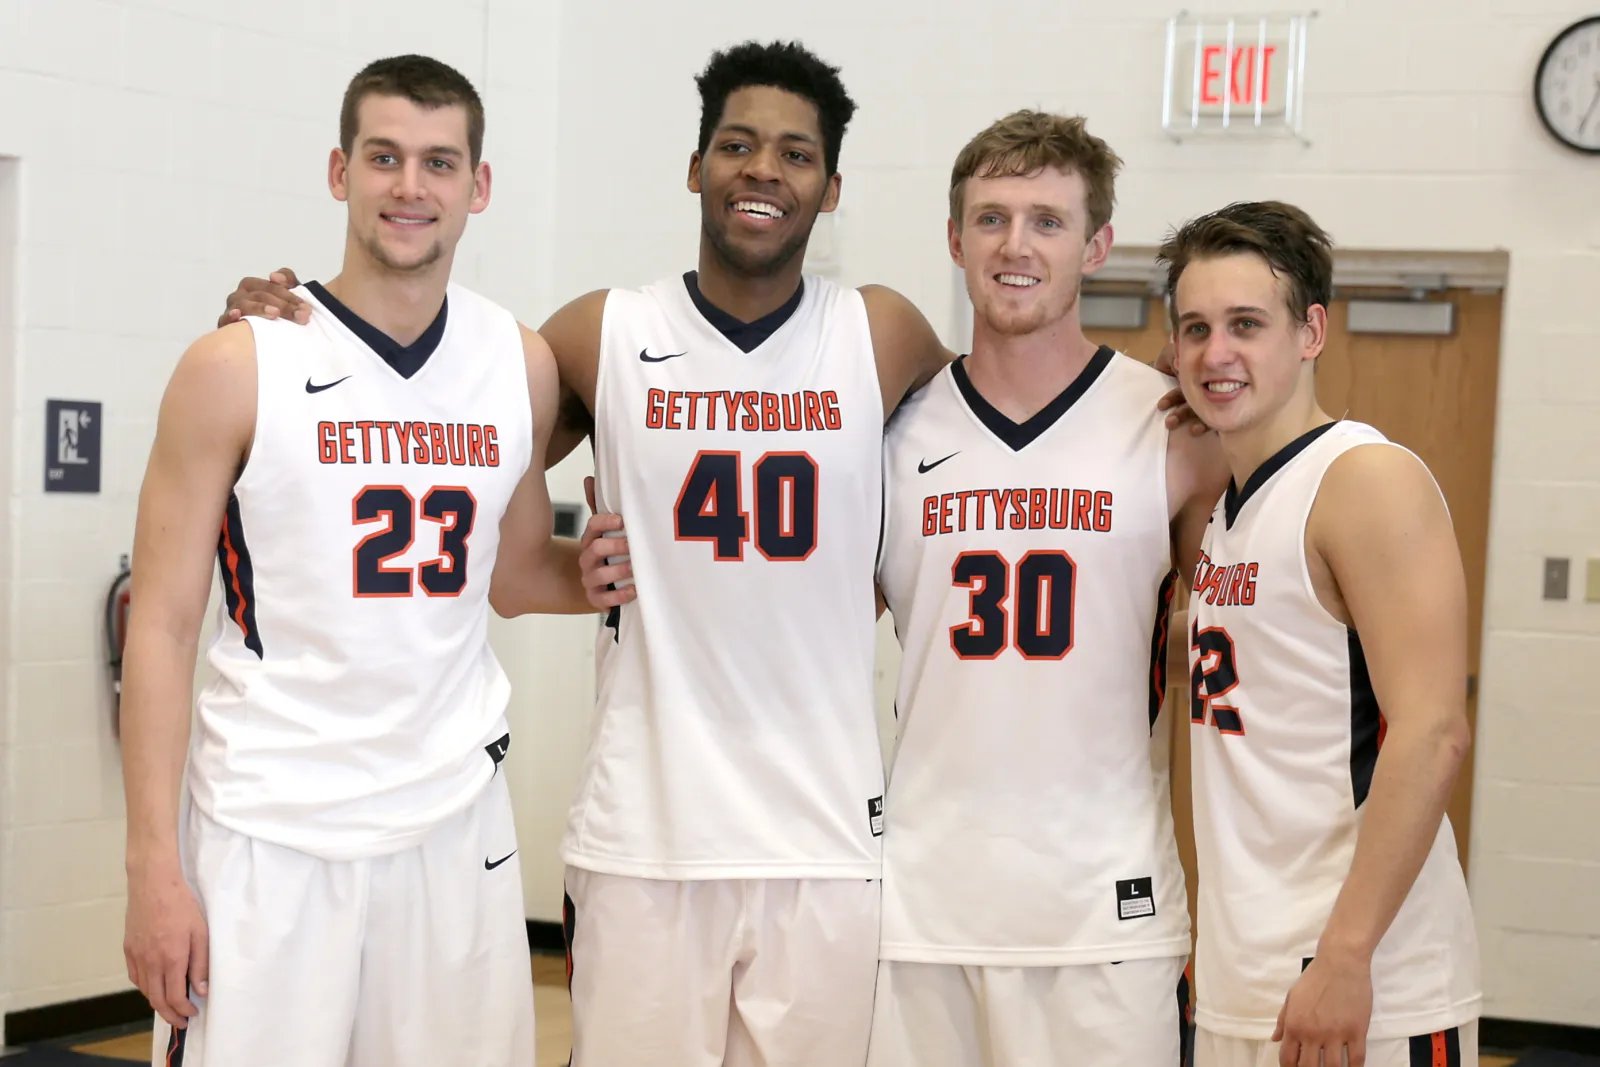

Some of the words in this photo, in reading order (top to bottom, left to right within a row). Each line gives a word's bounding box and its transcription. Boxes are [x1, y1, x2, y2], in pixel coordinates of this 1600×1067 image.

[1200, 46, 1276, 104] EXIT
[646, 388, 842, 432] GETTYSBURG
[318, 420, 500, 467] GETTYSBURG
[673, 450, 819, 562] 40
[922, 488, 1113, 537] GETTYSBURG
[352, 485, 477, 598] 23
[949, 550, 1077, 661] 30
[497, 744, 507, 756] L
[1131, 883, 1139, 895] L
